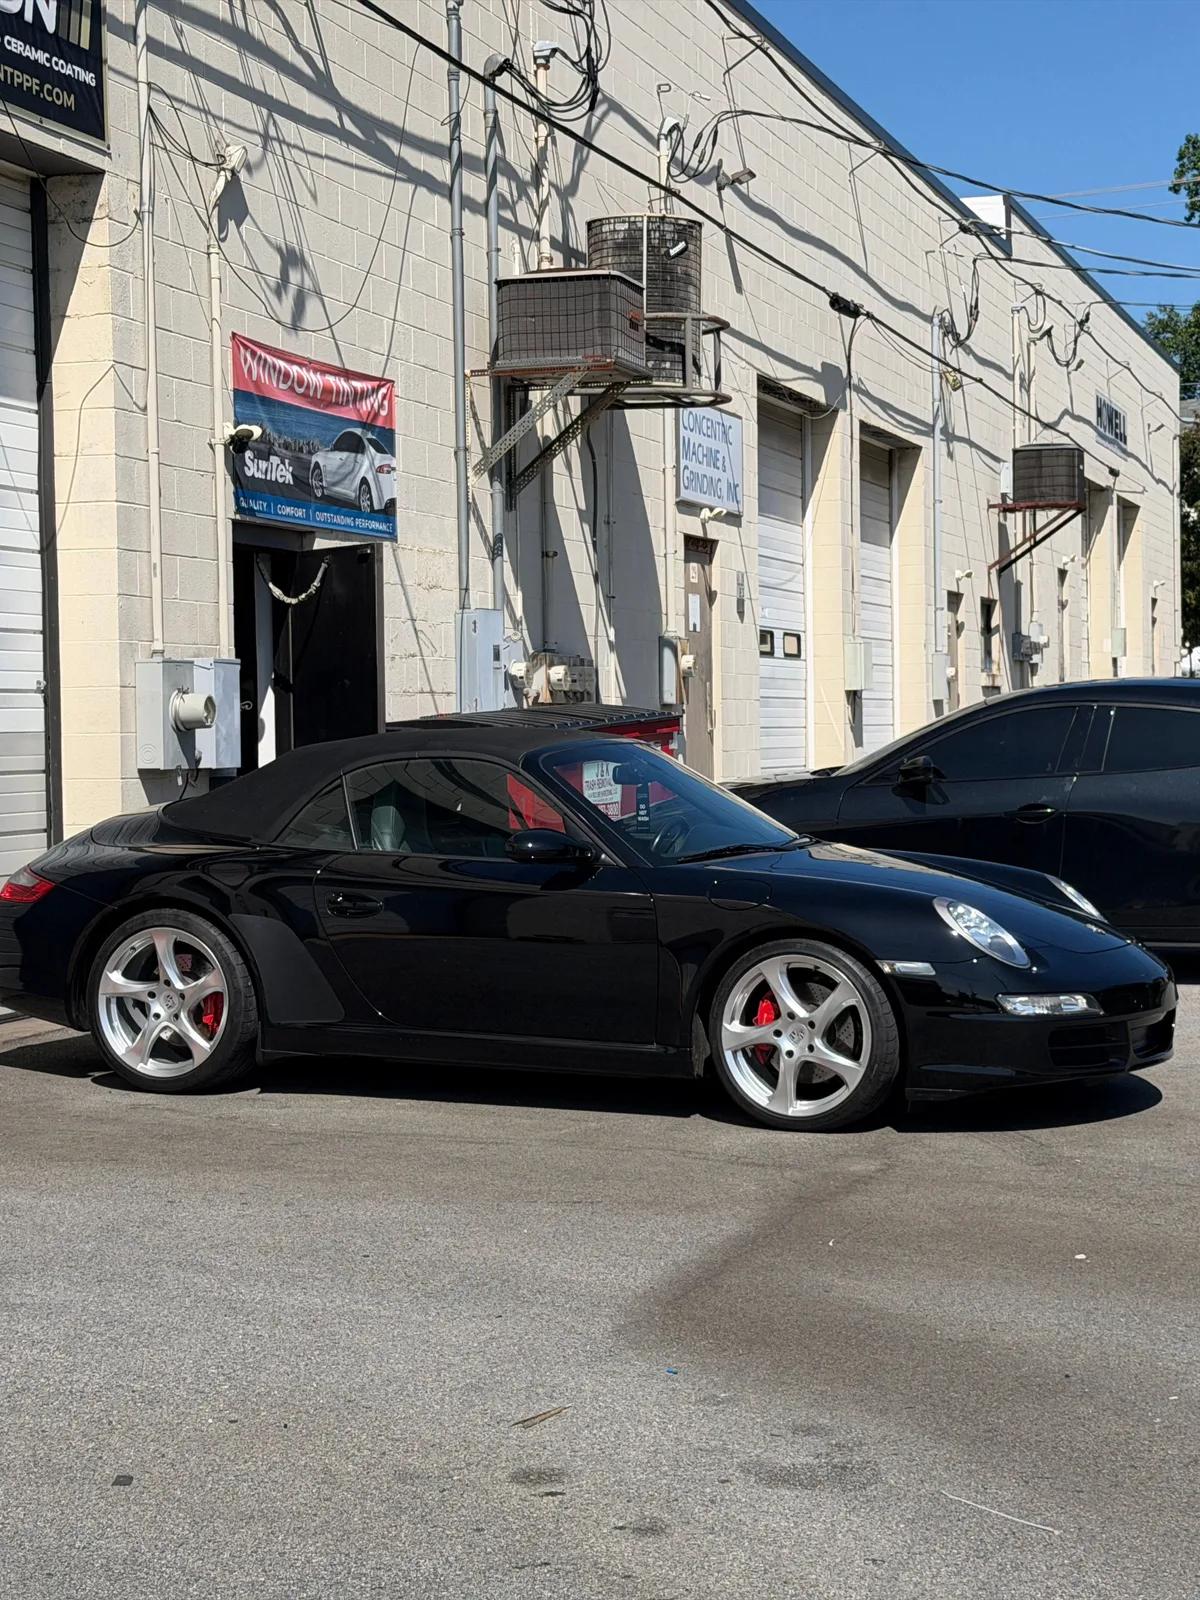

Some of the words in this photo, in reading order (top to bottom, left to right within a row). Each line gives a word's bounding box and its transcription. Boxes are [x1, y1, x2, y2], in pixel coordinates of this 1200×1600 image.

[4, 35, 51, 67] CERAMIC
[51, 56, 96, 87] COATING
[239, 346, 323, 400] WINDOW
[324, 374, 389, 417] TINTING
[682, 408, 733, 446] CONCENTRIC
[1096, 394, 1127, 446] HOWELL
[244, 451, 294, 485] SunTek
[682, 436, 720, 470] MACHINE
[721, 456, 727, 473] &
[240, 497, 267, 511] QUALITY
[277, 504, 306, 519] COMFORT
[315, 511, 354, 527] OUTSTANDING
[355, 517, 393, 533] PERFORMANCE
